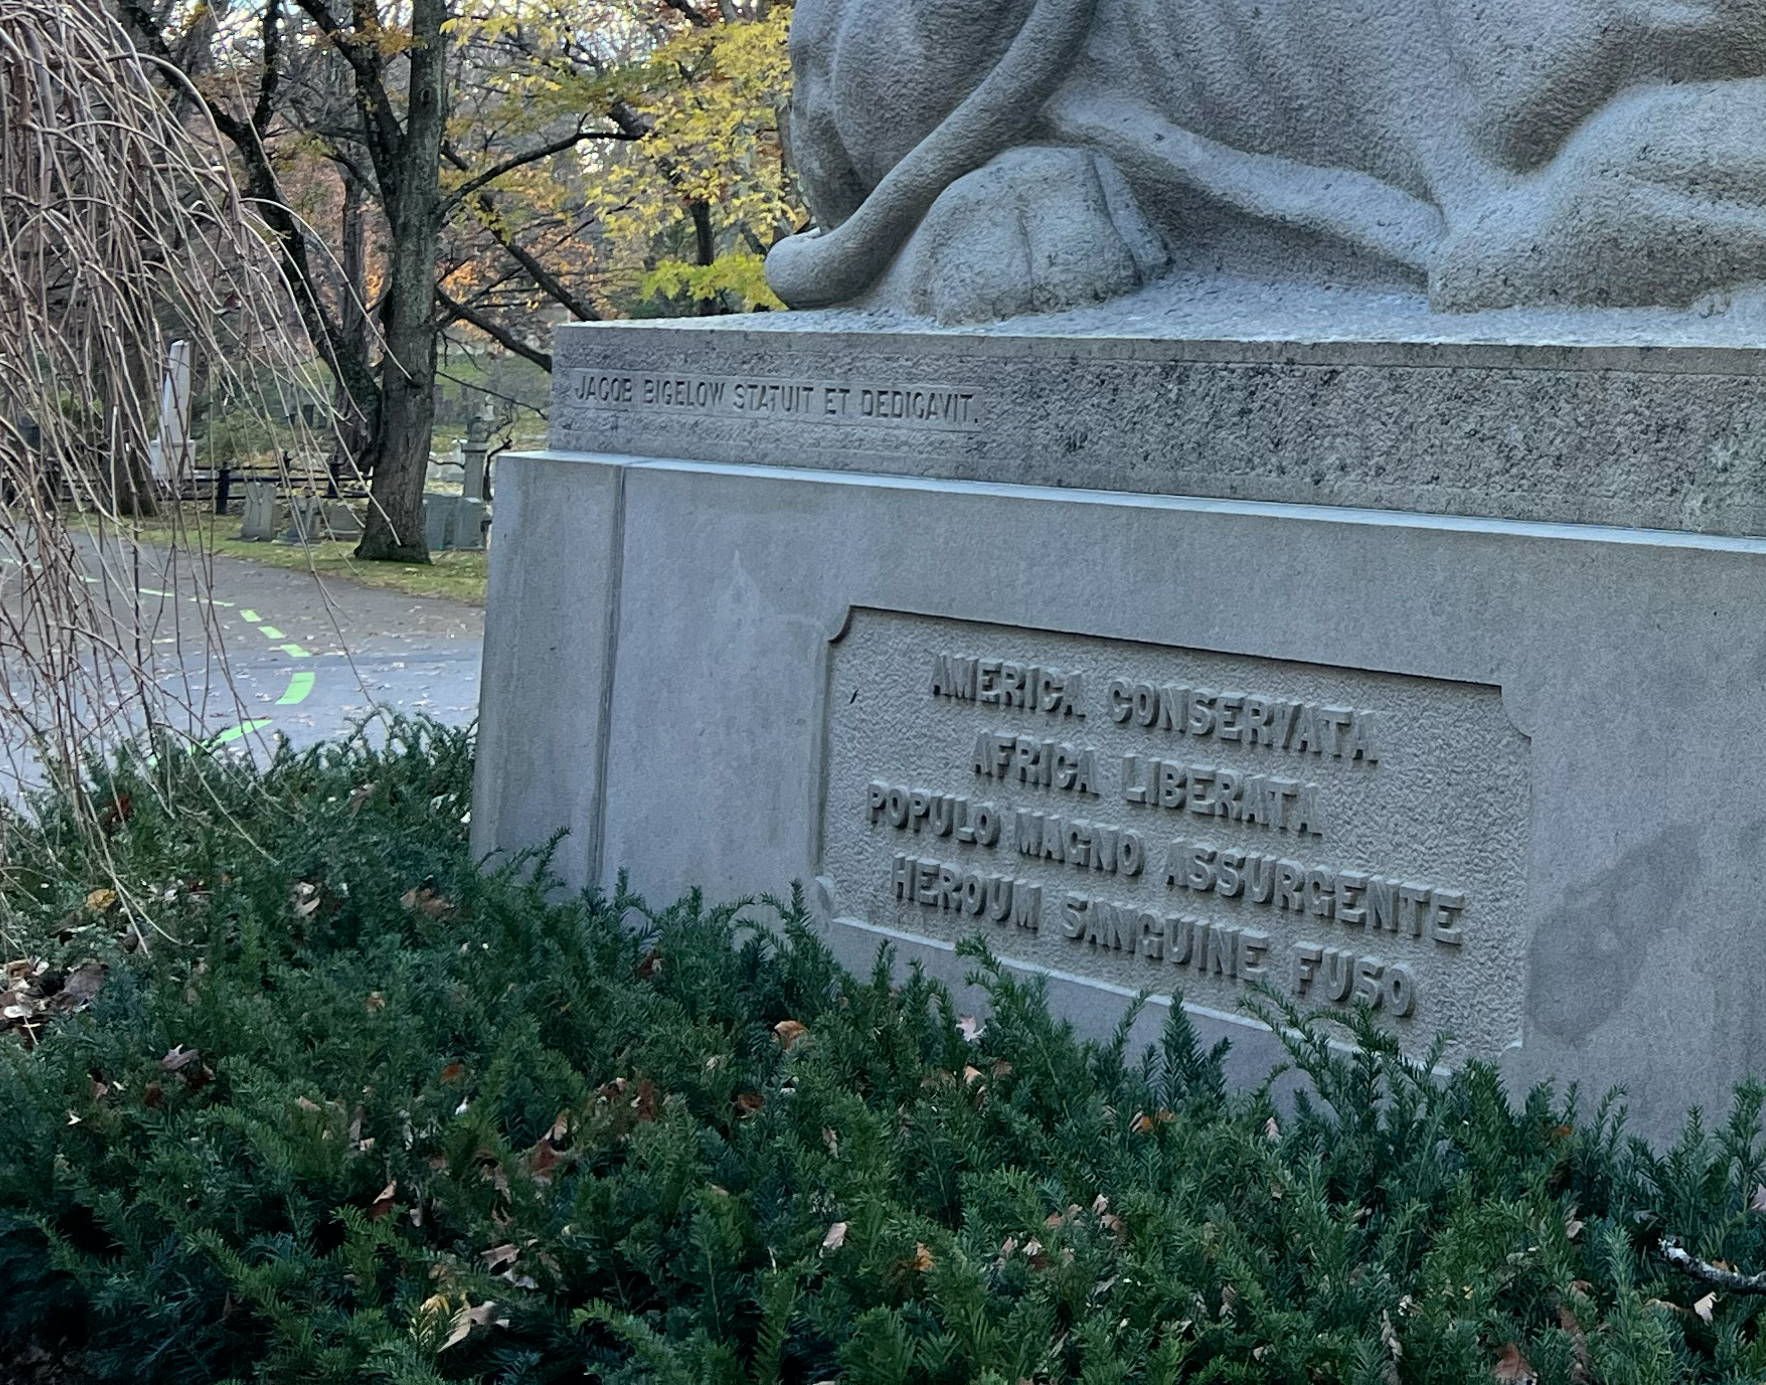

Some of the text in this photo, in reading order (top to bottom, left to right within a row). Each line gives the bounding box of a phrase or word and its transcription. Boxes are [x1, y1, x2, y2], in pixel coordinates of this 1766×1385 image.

[575, 375, 633, 403] JACOB
[643, 378, 725, 409] BIGELOW
[732, 383, 814, 415] STATUIT
[823, 387, 851, 416] ET
[931, 652, 1379, 764] AMERICA CONSERVATA
[973, 729, 1323, 837] AFRICA LIBERATA
[867, 779, 1465, 946] POPULO MAGNO ASSURGENTE
[891, 851, 1416, 1017] HEROUM SANGUINE FUSO
